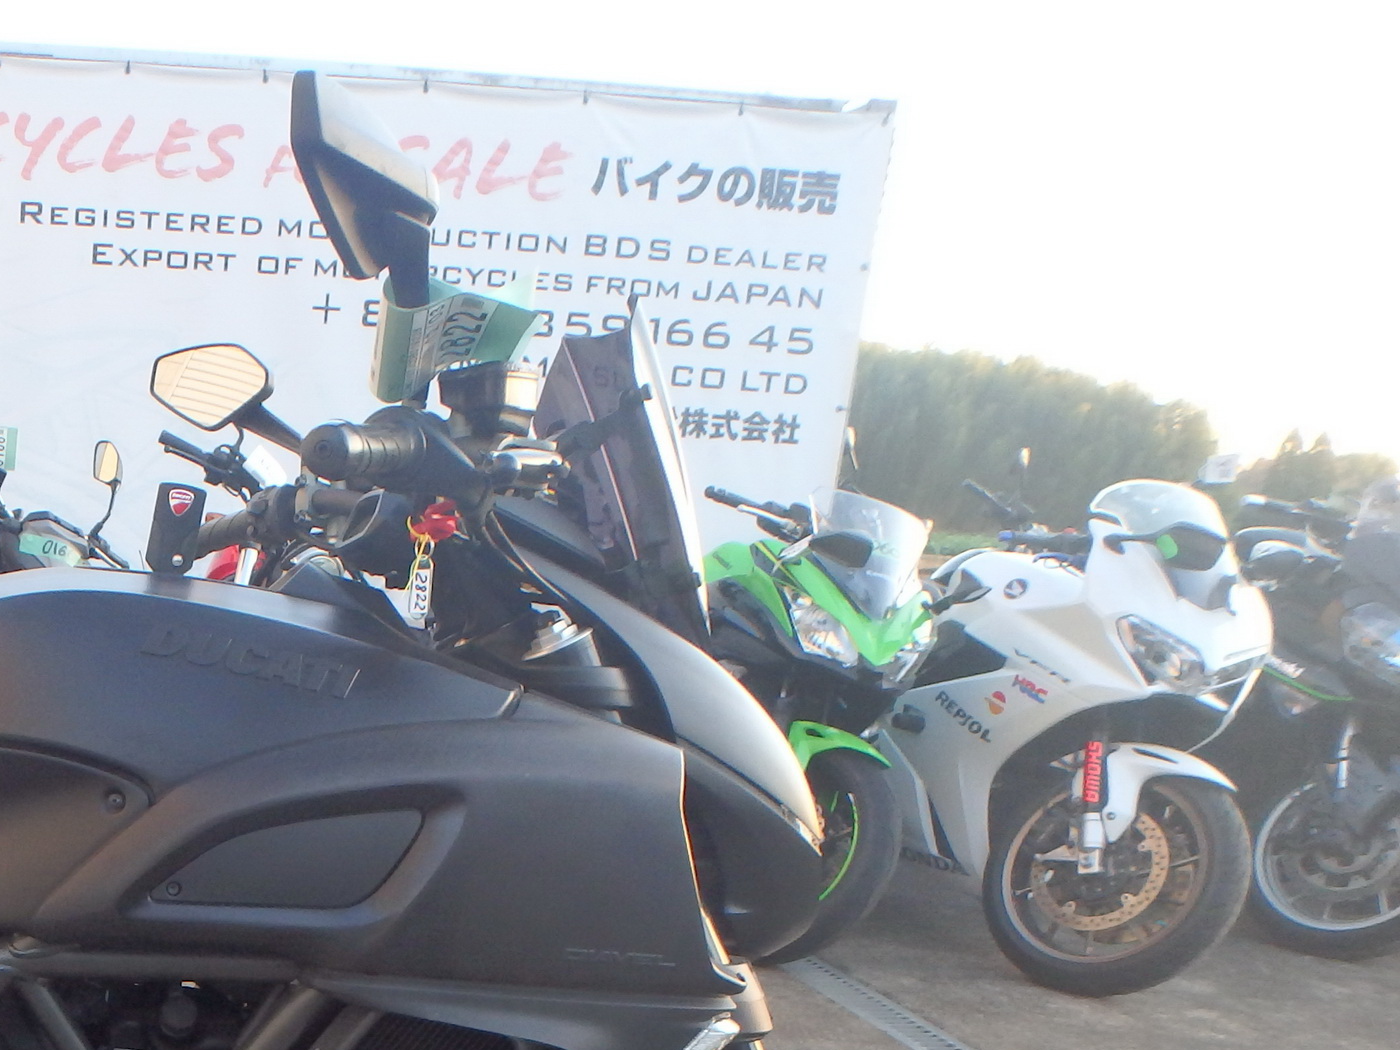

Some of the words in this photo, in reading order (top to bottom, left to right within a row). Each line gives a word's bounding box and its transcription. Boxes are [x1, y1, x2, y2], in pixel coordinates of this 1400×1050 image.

[591, 156, 840, 215] バイクの販売
[20, 201, 263, 236] REGISTERED
[431, 228, 567, 255] UCTION
[584, 234, 671, 262] BDS
[686, 244, 827, 273] DEALER
[92, 242, 237, 274] EXPORT
[257, 255, 303, 275] OF
[586, 276, 680, 299] FROM
[692, 280, 824, 310] JAPAN
[649, 317, 730, 350] 166
[749, 325, 814, 355] 45
[671, 365, 726, 389] CO
[741, 370, 808, 395] LTD
[672, 405, 800, 444] 株式会社
[414, 571, 428, 611] 2822
[140, 628, 362, 700] DUCATI
[935, 690, 991, 743] REPSOL
